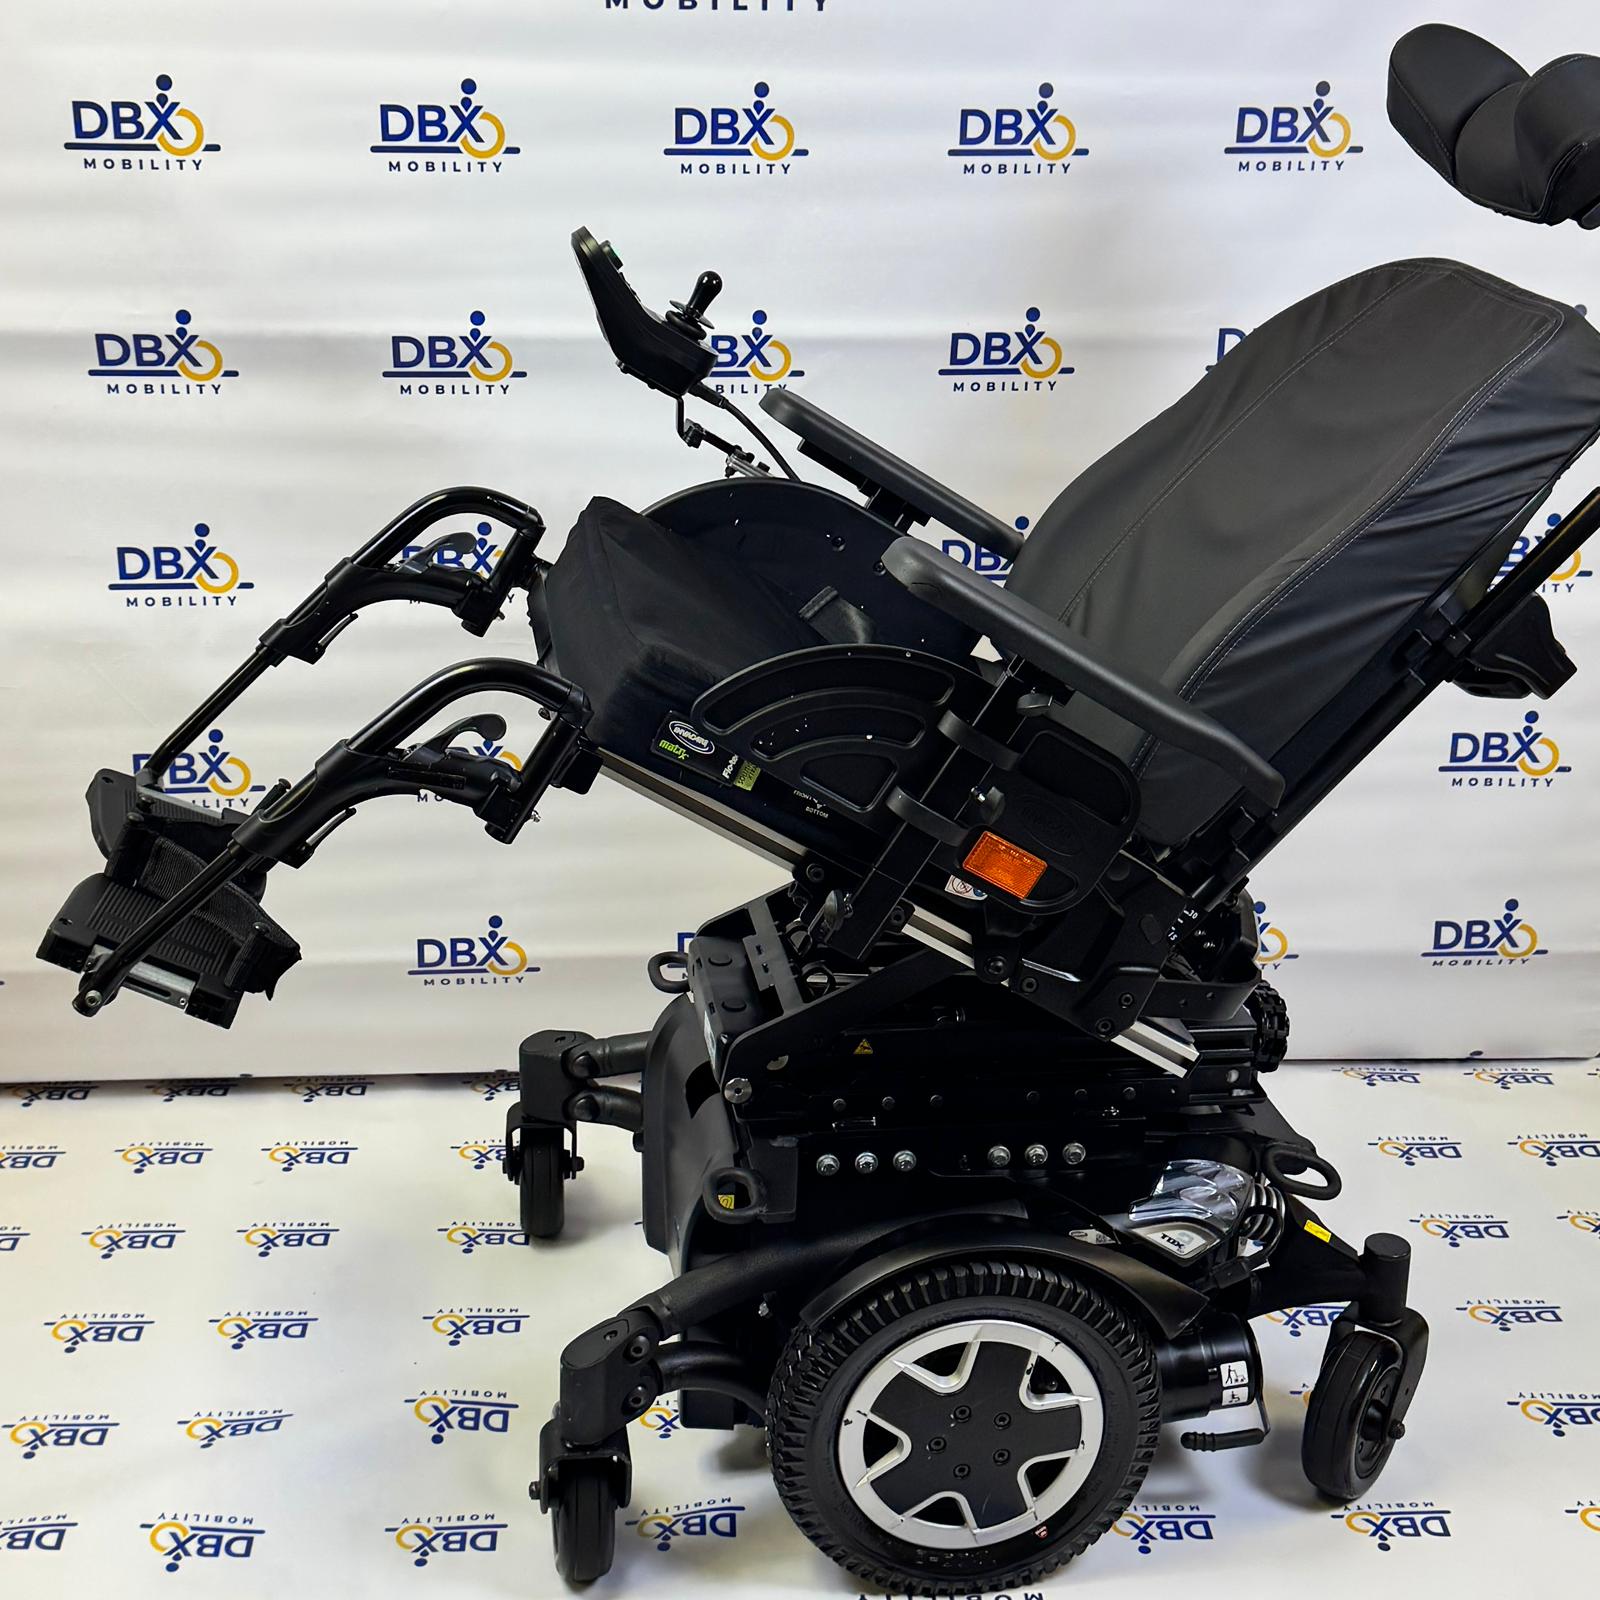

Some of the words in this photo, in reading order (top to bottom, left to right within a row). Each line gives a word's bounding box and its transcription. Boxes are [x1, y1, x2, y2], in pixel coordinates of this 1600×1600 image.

[72, 101, 183, 140] DBX
[380, 104, 484, 143] DBX
[675, 108, 775, 145] DBX
[959, 109, 1058, 145] DBX
[1236, 107, 1334, 143] DBX
[83, 157, 204, 171] MOBILITY
[388, 160, 504, 173] MOBILITY
[681, 163, 790, 174] MOBILITY
[964, 163, 1070, 174] MOBILITY
[1239, 161, 1344, 172] MOBILITY
[95, 334, 202, 367] DBX
[392, 336, 492, 368] DBX
[711, 335, 774, 367] BX
[950, 332, 1045, 365] DBX
[107, 384, 221, 394] MOBILITY
[400, 385, 509, 395] MOBILITY
[953, 381, 1056, 392] MOBILITY
[942, 540, 1013, 571] DB
[117, 547, 219, 580] DBX
[127, 596, 236, 607] MOBILITY
[1449, 732, 1540, 763] DBX
[1452, 778, 1553, 787] MOBILITY
[1188, 909, 1199, 920] 30
[1167, 931, 1178, 941] 15
[1433, 919, 1522, 950] DBX
[417, 937, 508, 968] DBX
[424, 976, 525, 986] MOBILITY
[303, 1084, 367, 1096] DBX
[483, 1080, 520, 1094] BX
[134, 1152, 203, 1164] DBX
[284, 1152, 349, 1164] DBX
[1396, 1145, 1462, 1159] DBX
[1439, 1225, 1510, 1238] DBX
[103, 1234, 176, 1249] DBX
[258, 1233, 330, 1247] DBX
[459, 1233, 531, 1246] DBX
[1160, 1232, 1185, 1250] TDX
[1489, 1307, 1563, 1324] DBX
[66, 1326, 144, 1342] DBX
[231, 1323, 308, 1339] DBX
[448, 1320, 521, 1336] DBX
[420, 1390, 507, 1398] MOBILITY
[20, 1414, 109, 1422] MOBILITY
[195, 1409, 282, 1417] MOBILITY
[429, 1405, 509, 1432] DBX
[199, 1416, 283, 1441] DBX
[25, 1427, 108, 1447] DBX
[640, 1497, 731, 1516] MOBILITY
[1133, 1504, 1200, 1512] MOBILI
[1343, 1501, 1434, 1510] MOBILITY
[0, 1514, 67, 1524] MOBIL
[158, 1513, 253, 1525] MOBILITY
[402, 1514, 494, 1524] MOBILITY
[654, 1513, 736, 1539] DBX
[1365, 1516, 1451, 1537] DBX
[1126, 1520, 1213, 1540] DBX
[0, 1528, 66, 1550] DB
[165, 1530, 254, 1557] DBX
[412, 1529, 497, 1552] DBX
